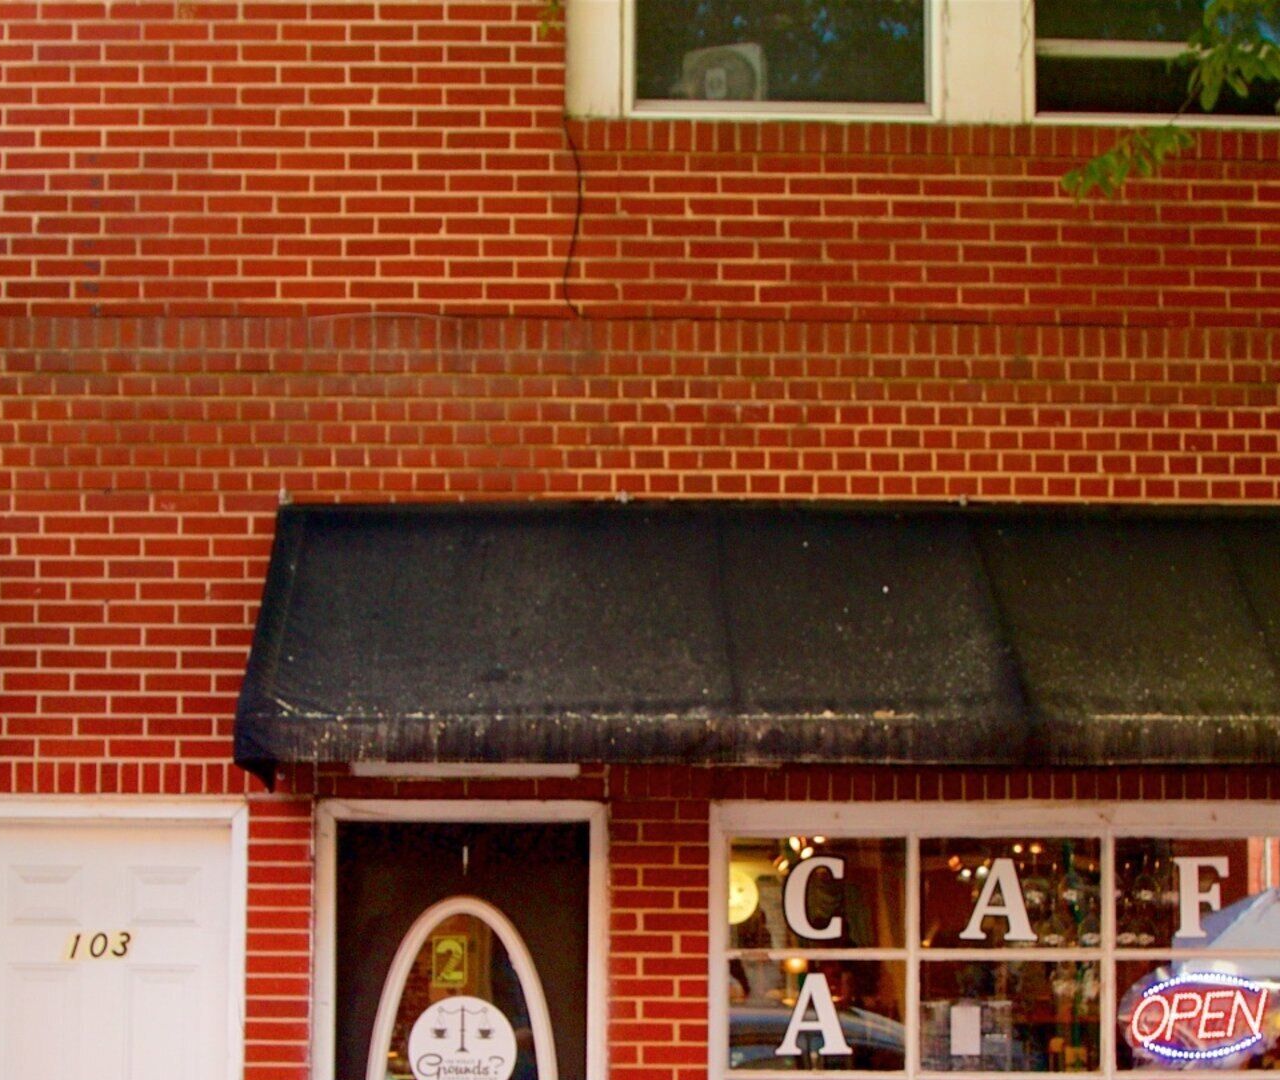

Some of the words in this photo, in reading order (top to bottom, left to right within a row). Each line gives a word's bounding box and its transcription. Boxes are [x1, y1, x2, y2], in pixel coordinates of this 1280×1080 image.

[69, 932, 131, 959] 103
[434, 938, 464, 981] 2
[1131, 988, 1268, 1043] OPEN
[416, 1053, 505, 1080] Grounds?
